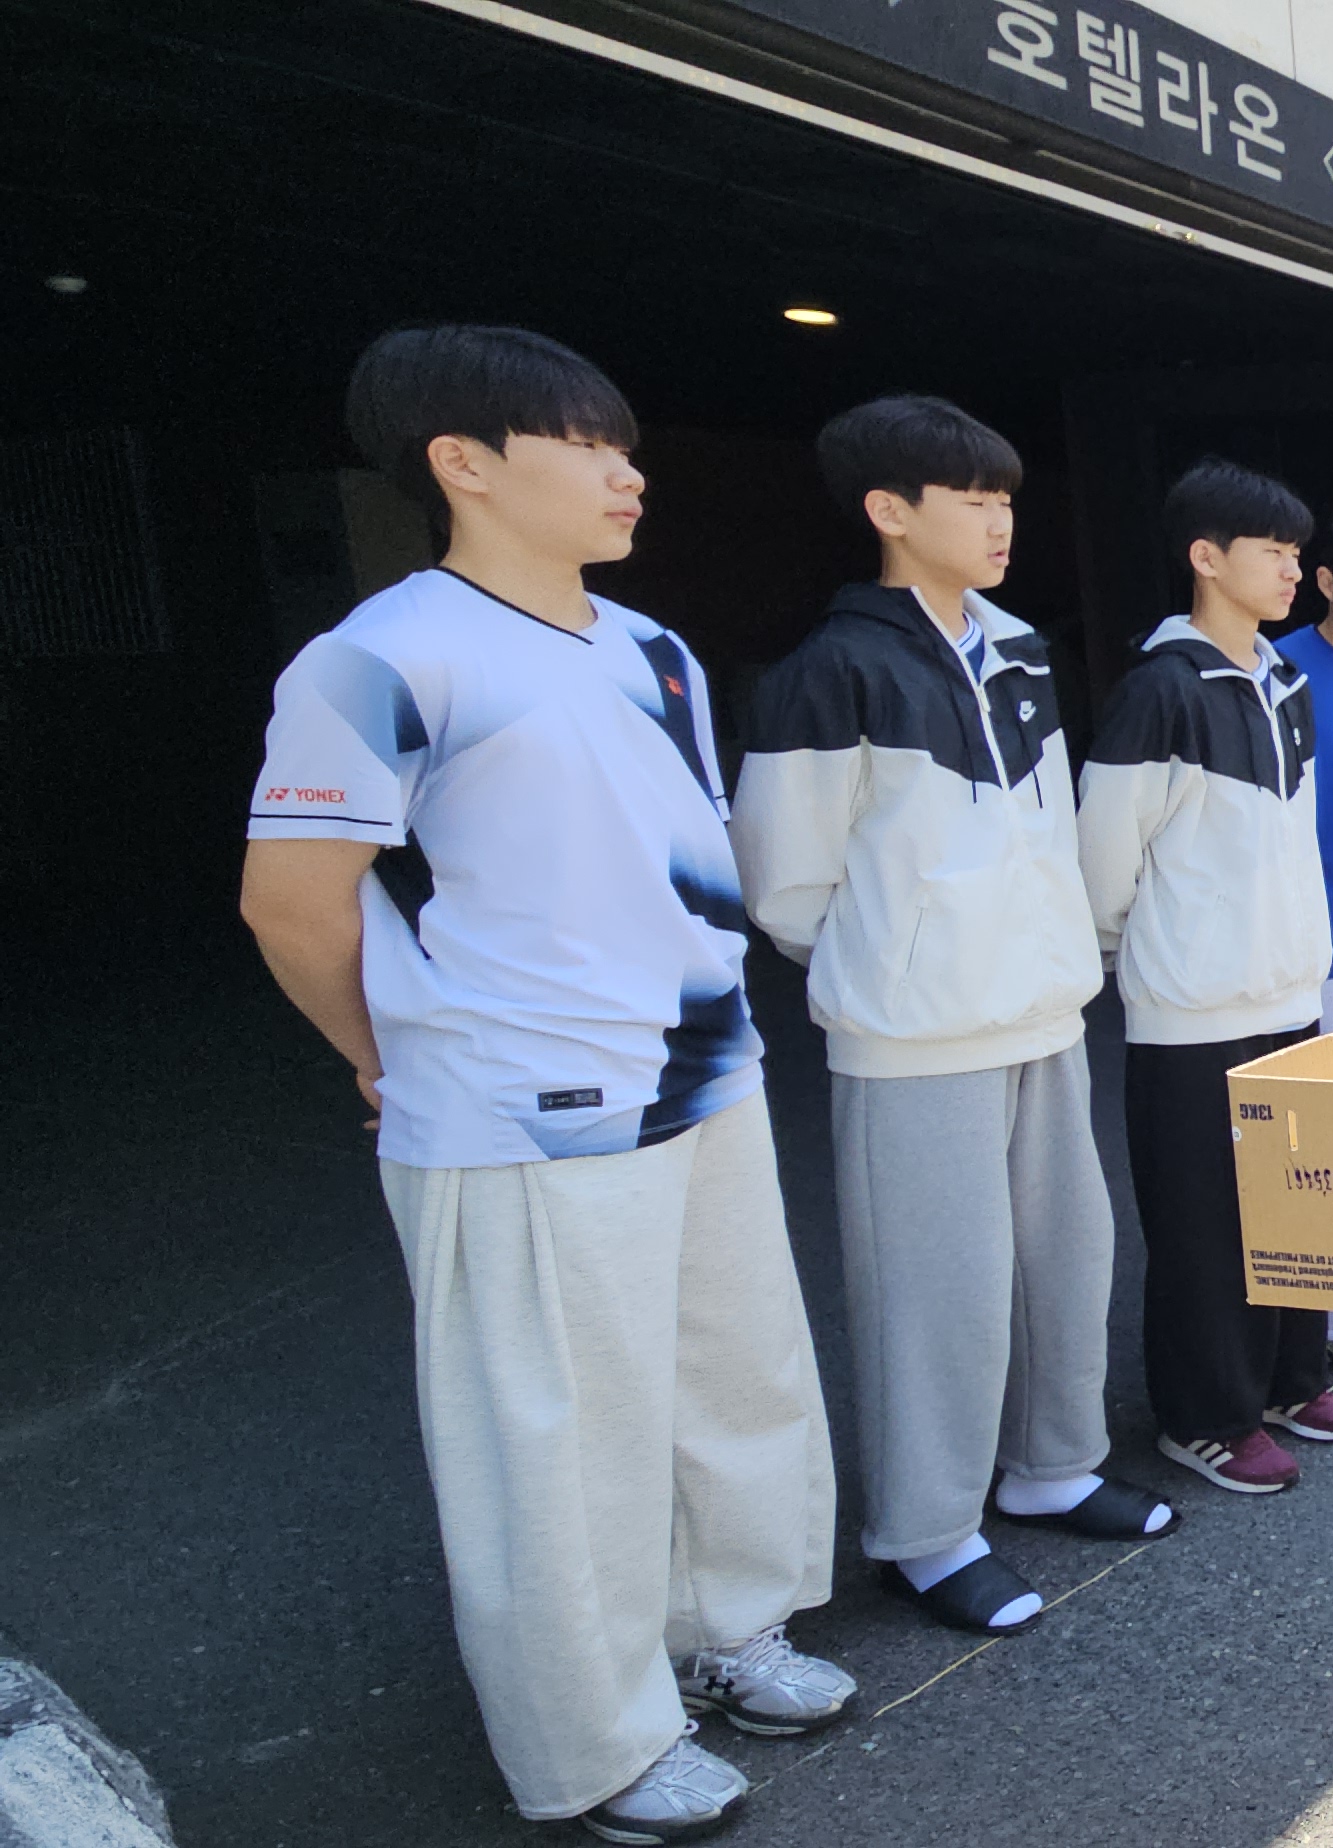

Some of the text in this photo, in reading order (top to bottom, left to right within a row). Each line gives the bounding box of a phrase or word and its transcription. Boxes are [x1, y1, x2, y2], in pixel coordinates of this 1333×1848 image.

[987, 0, 1286, 182] 호텔라온
[294, 787, 347, 804] YONEX
[1239, 1103, 1274, 1121] 13KG
